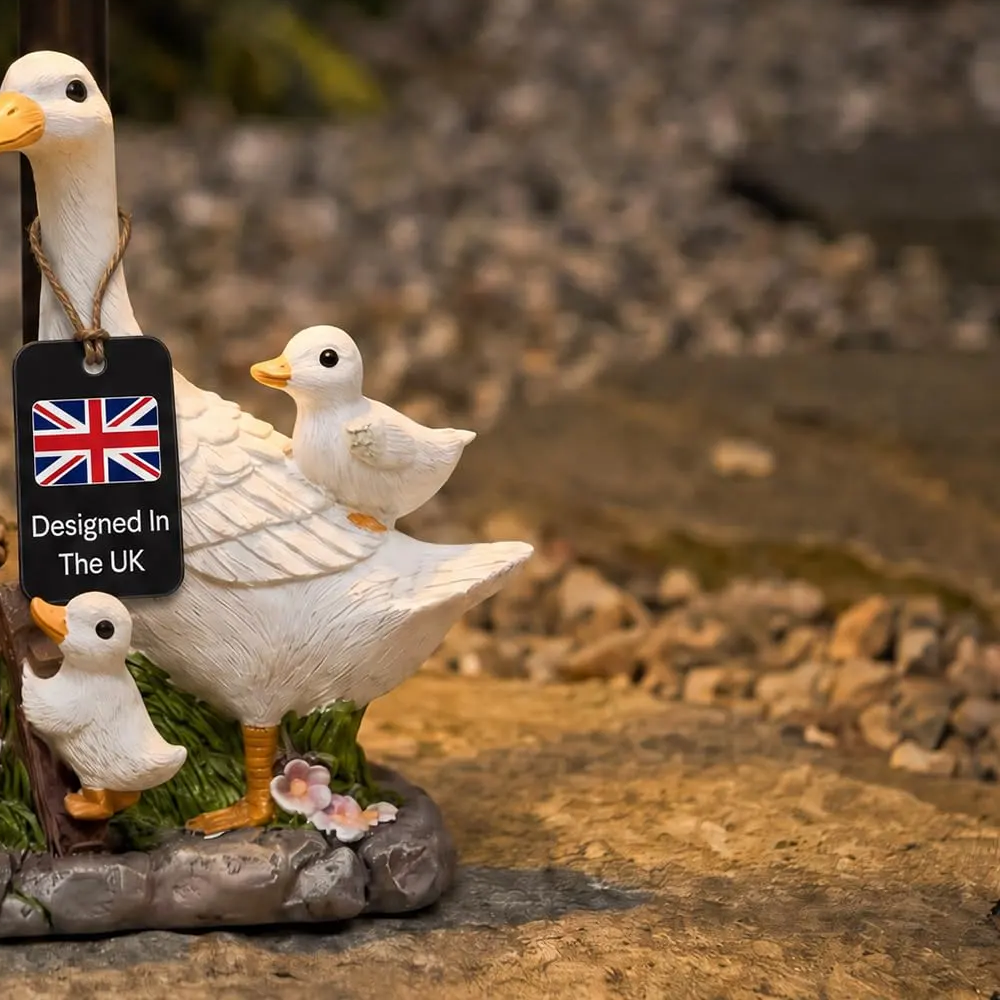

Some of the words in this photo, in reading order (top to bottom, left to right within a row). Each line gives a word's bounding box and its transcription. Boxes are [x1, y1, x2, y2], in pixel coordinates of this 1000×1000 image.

[31, 509, 142, 542] Designed
[149, 509, 170, 532] In
[58, 552, 103, 576] The
[110, 548, 146, 573] UK
